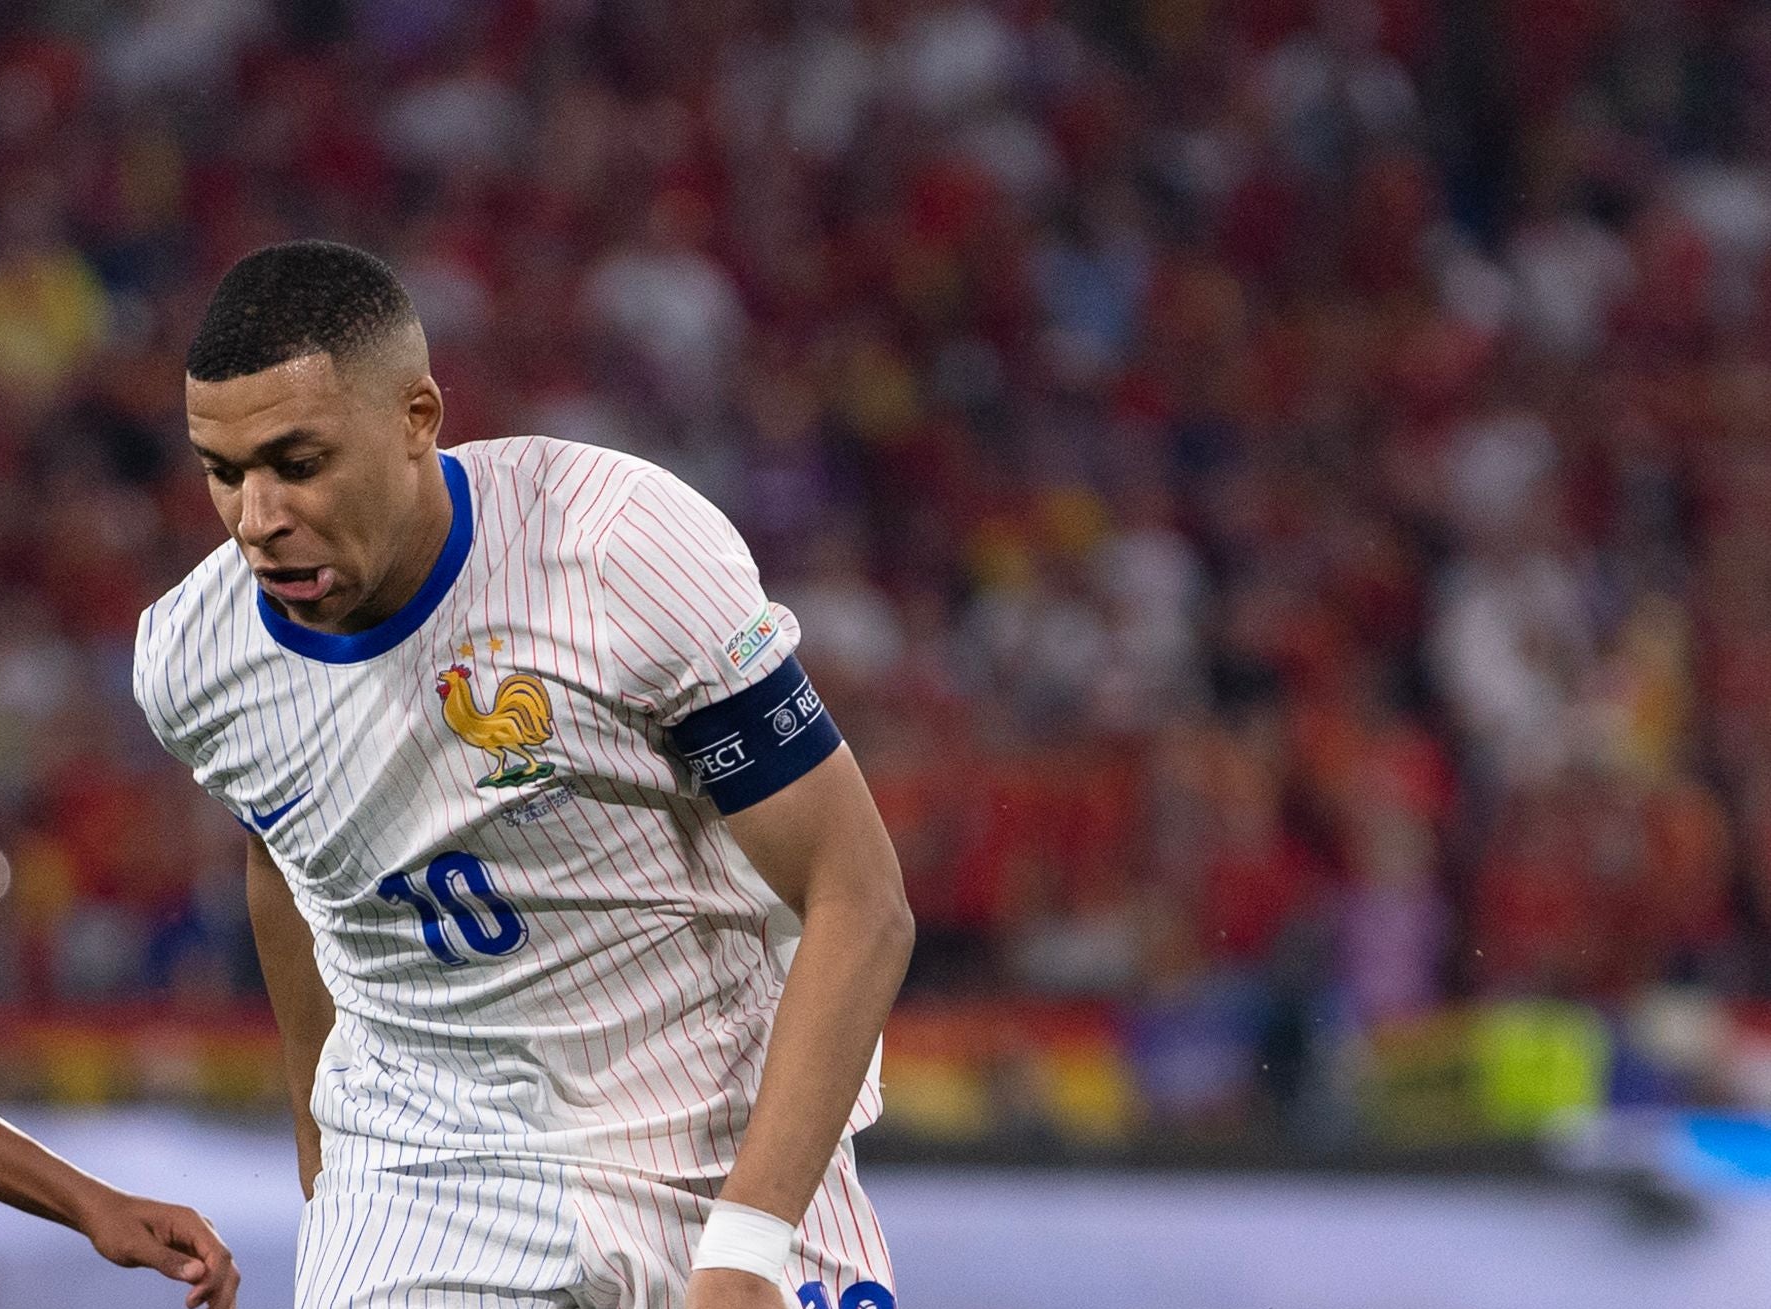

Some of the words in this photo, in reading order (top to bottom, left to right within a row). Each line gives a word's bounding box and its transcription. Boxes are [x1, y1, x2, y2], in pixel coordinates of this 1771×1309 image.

[725, 631, 745, 654] UEFA
[730, 616, 774, 667] FOUN
[376, 851, 529, 966] 10
